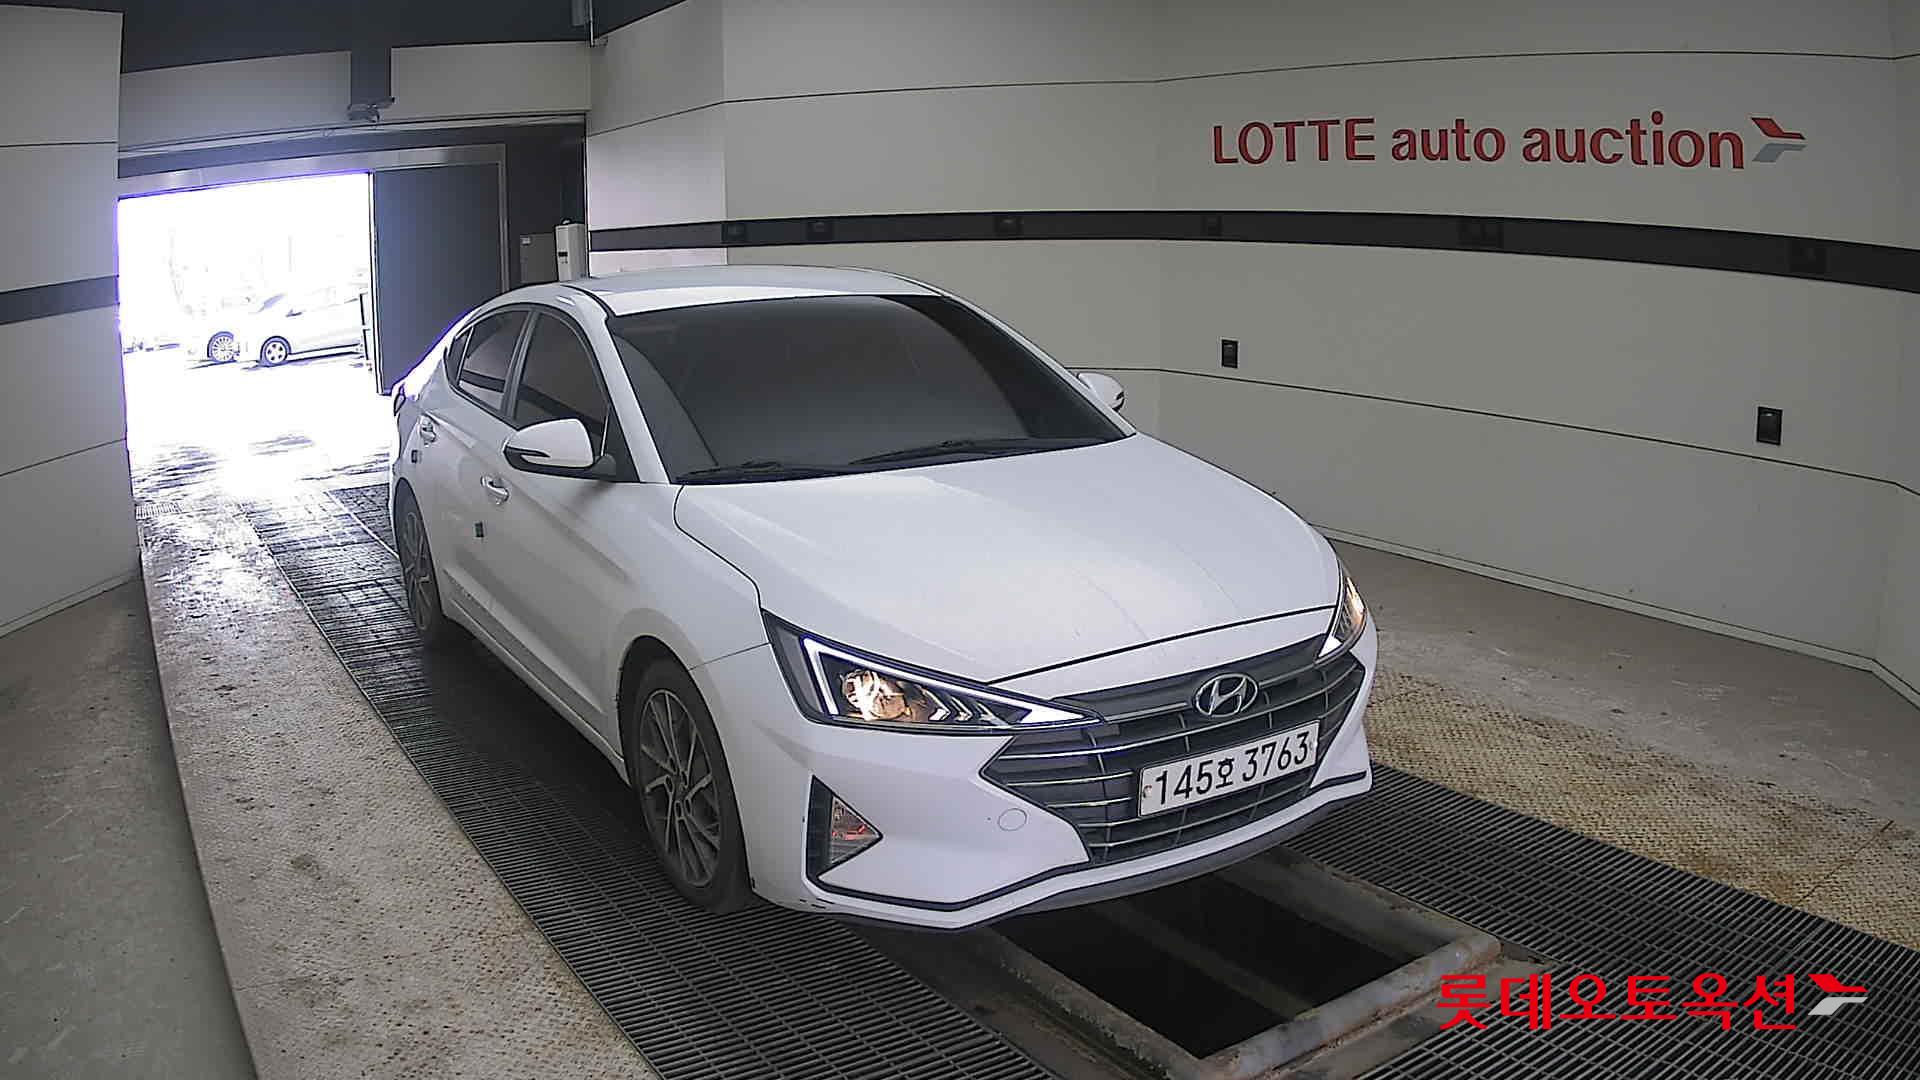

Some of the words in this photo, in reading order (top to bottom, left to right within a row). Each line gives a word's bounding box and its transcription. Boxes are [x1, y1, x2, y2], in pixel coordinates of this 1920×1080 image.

[1213, 118, 1375, 164] LOTTE
[1391, 118, 1506, 162] auto
[1521, 111, 1744, 169] auction
[1155, 757, 1234, 805] 145호
[1242, 731, 1310, 782] 3763
